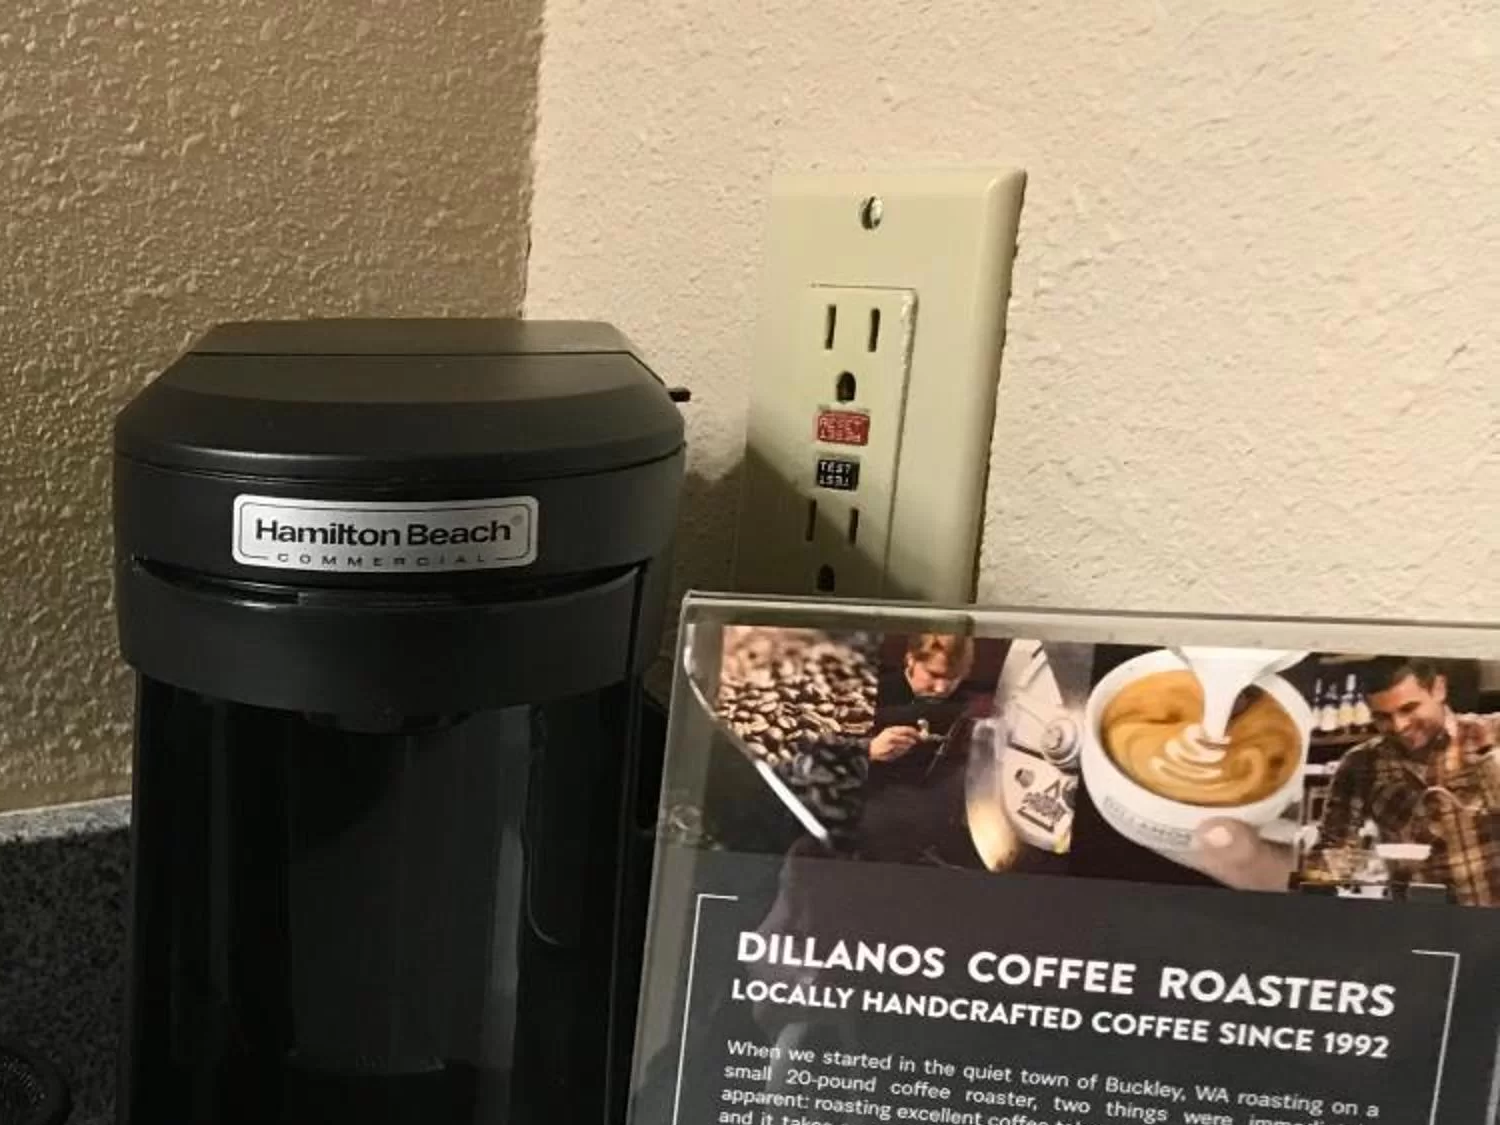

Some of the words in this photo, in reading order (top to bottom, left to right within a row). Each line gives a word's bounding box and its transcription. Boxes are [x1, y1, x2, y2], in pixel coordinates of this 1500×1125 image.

[255, 517, 400, 546] Hamilton
[407, 520, 512, 546] Beach
[277, 553, 486, 567] COMMERCIAL
[735, 930, 946, 979] DILLANOS
[966, 949, 1137, 996] COFFEE
[1157, 965, 1397, 1017] ROASTERS
[730, 976, 856, 1009] LOCALLY
[860, 988, 1083, 1031] HANDCRAFTED
[1090, 1009, 1211, 1043] COFFEE
[1217, 1020, 1315, 1052] SINCE
[1322, 1030, 1390, 1059] 1992
[722, 1064, 773, 1082] small
[784, 1067, 877, 1093] 20-pound
[888, 1079, 951, 1100] coffee
[964, 1089, 1038, 1112] roaster,
[1052, 1095, 1091, 1114] two
[1104, 1100, 1169, 1125] things
[726, 1038, 781, 1060] When
[787, 1048, 816, 1063] we
[821, 1049, 893, 1071] started
[898, 1054, 916, 1073] in
[922, 1057, 956, 1077] the
[961, 1062, 1012, 1083] quiet
[1019, 1068, 1069, 1088] town
[1075, 1072, 1099, 1091] of
[1104, 1074, 1187, 1102] Buckley,
[1193, 1084, 1230, 1104] WA
[1236, 1091, 1324, 1116] roasting
[1330, 1100, 1359, 1116] on
[1364, 1103, 1380, 1118] a
[717, 1110, 753, 1125] and
[720, 1087, 810, 1109] apparent:
[813, 1097, 892, 1121] roasting
